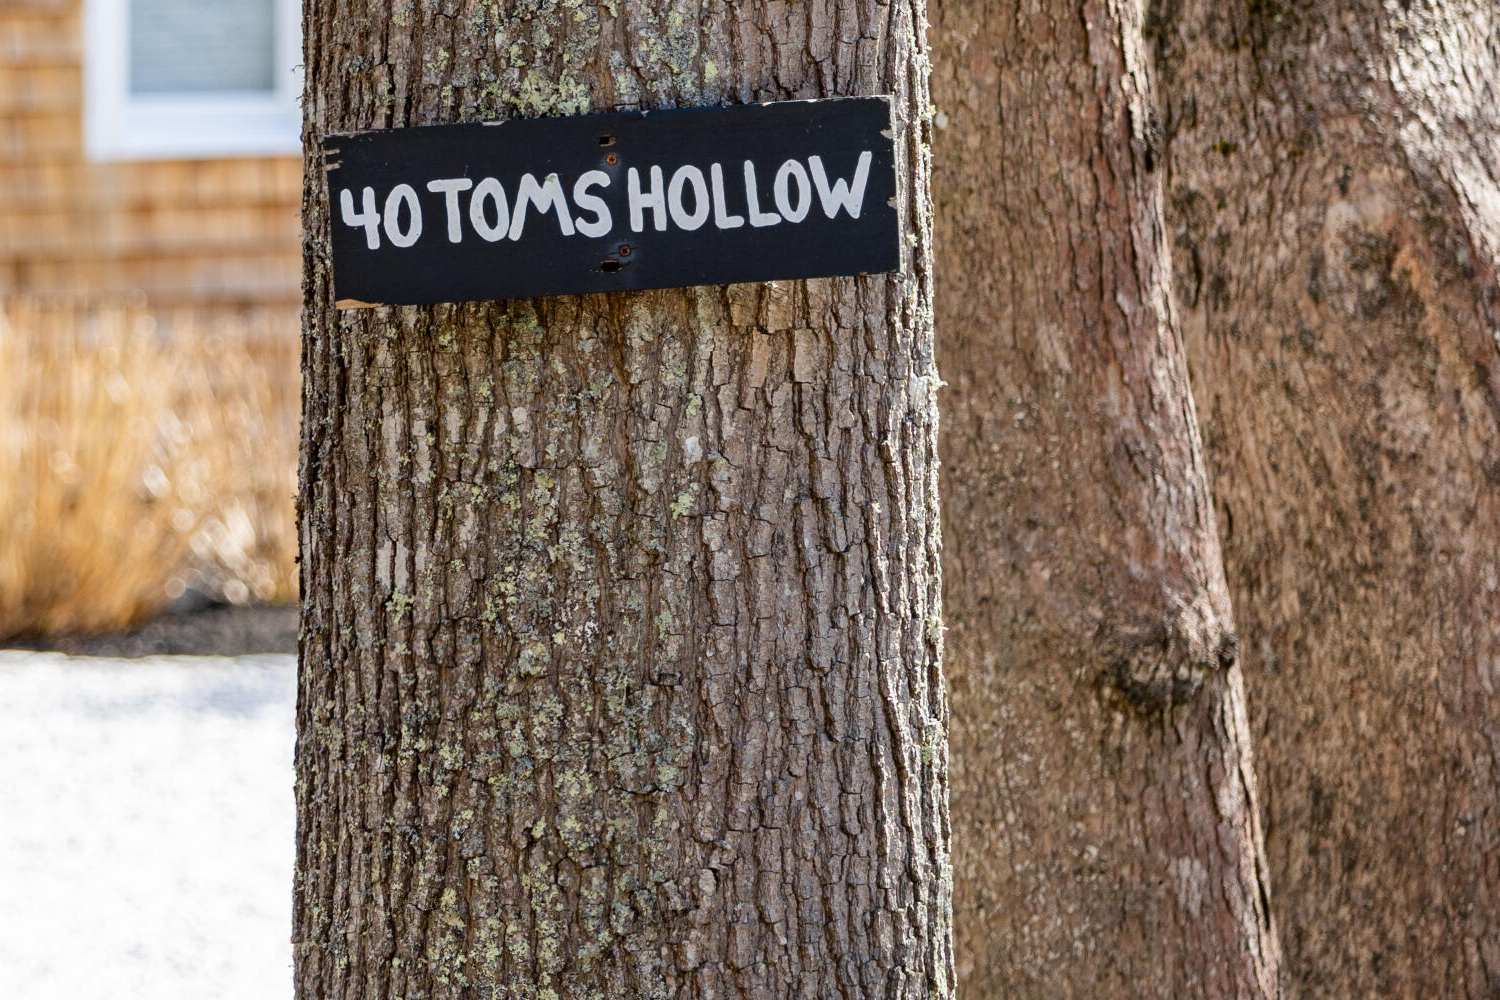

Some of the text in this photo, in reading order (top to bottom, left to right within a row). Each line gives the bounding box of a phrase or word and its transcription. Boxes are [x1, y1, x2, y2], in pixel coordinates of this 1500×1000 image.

[340, 150, 873, 250] 40 TOMS HOLLOW
